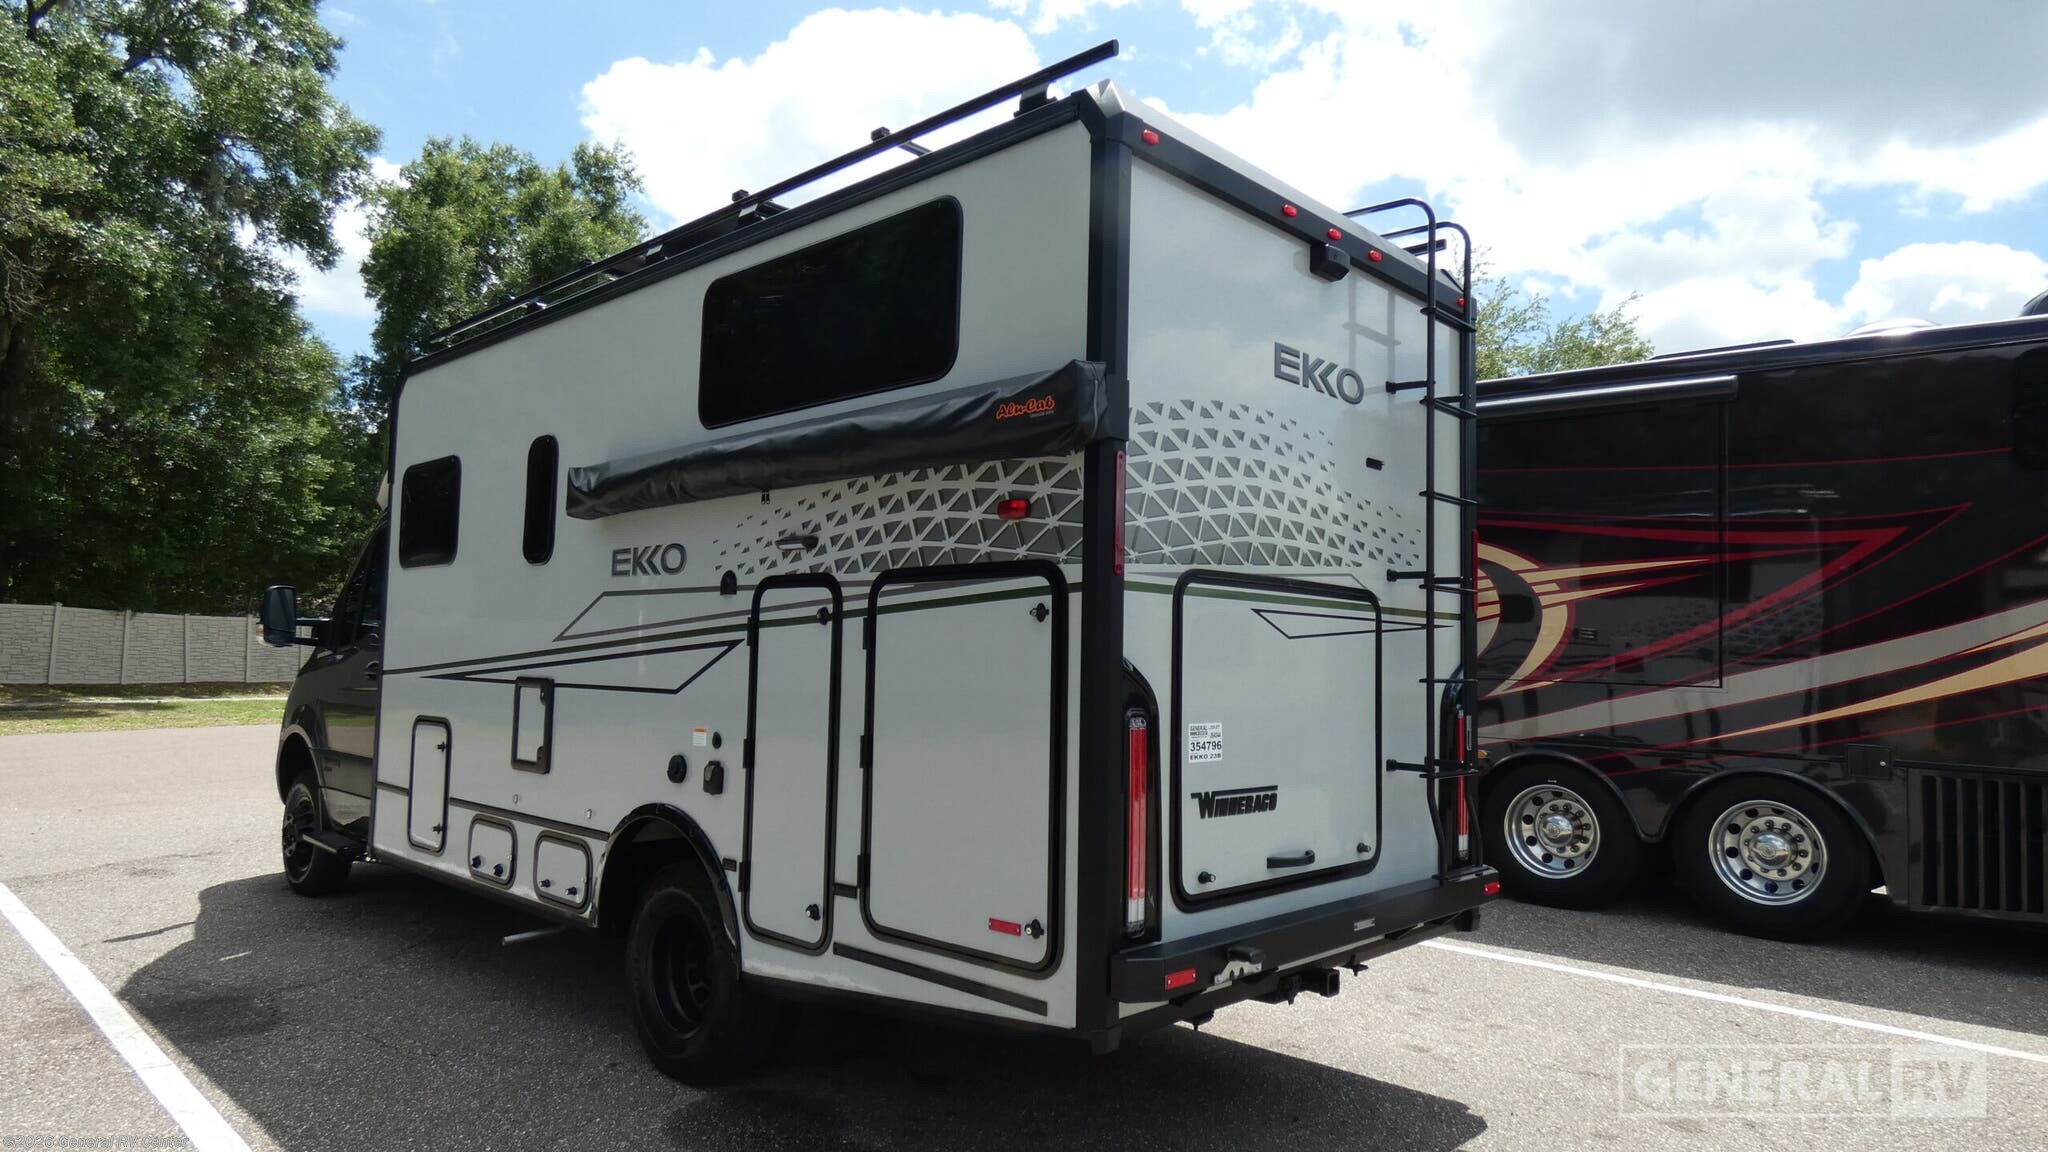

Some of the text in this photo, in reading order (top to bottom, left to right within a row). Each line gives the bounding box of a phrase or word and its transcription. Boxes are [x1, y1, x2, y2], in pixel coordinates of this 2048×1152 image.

[1274, 341, 1364, 405] EKKO
[996, 395, 1055, 419] Alu-Cab
[612, 543, 687, 576] EKKO
[1190, 741, 1222, 752] 354796
[1191, 785, 1278, 819] WINNEBAGO
